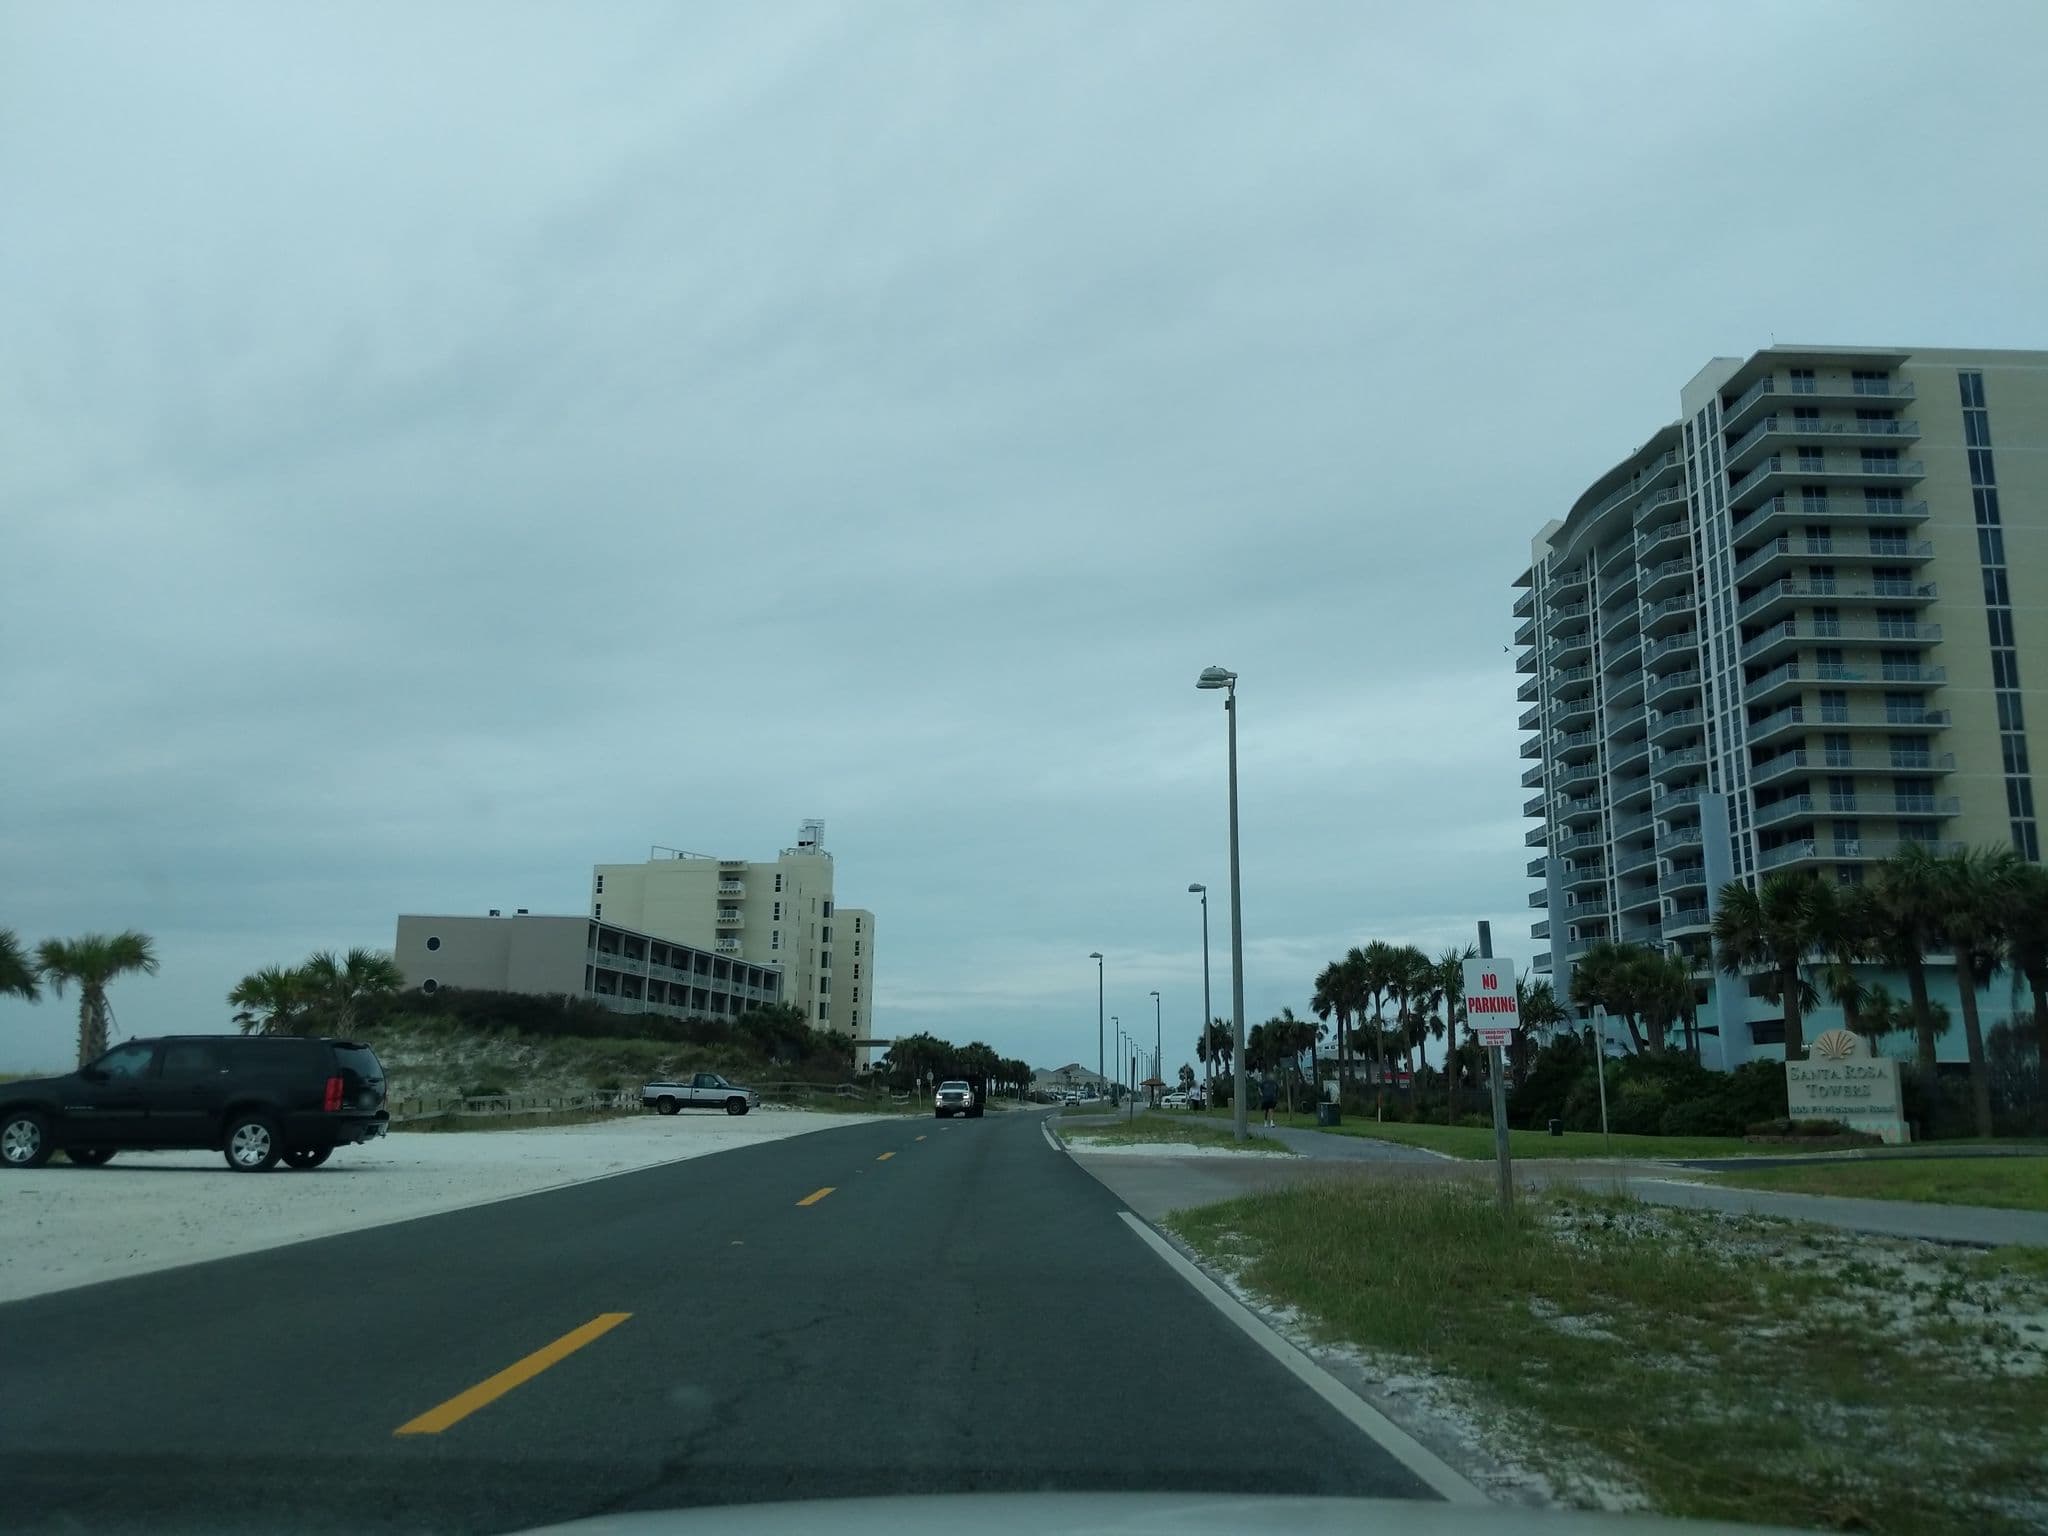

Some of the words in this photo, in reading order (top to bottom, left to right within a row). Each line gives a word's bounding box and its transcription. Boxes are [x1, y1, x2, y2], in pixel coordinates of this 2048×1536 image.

[1481, 973, 1498, 990] NO
[1468, 996, 1516, 1014] PARKING
[1791, 1067, 1842, 1080] SANTA
[1845, 1065, 1888, 1079] ROSA
[1806, 1084, 1871, 1098] TOWERS
